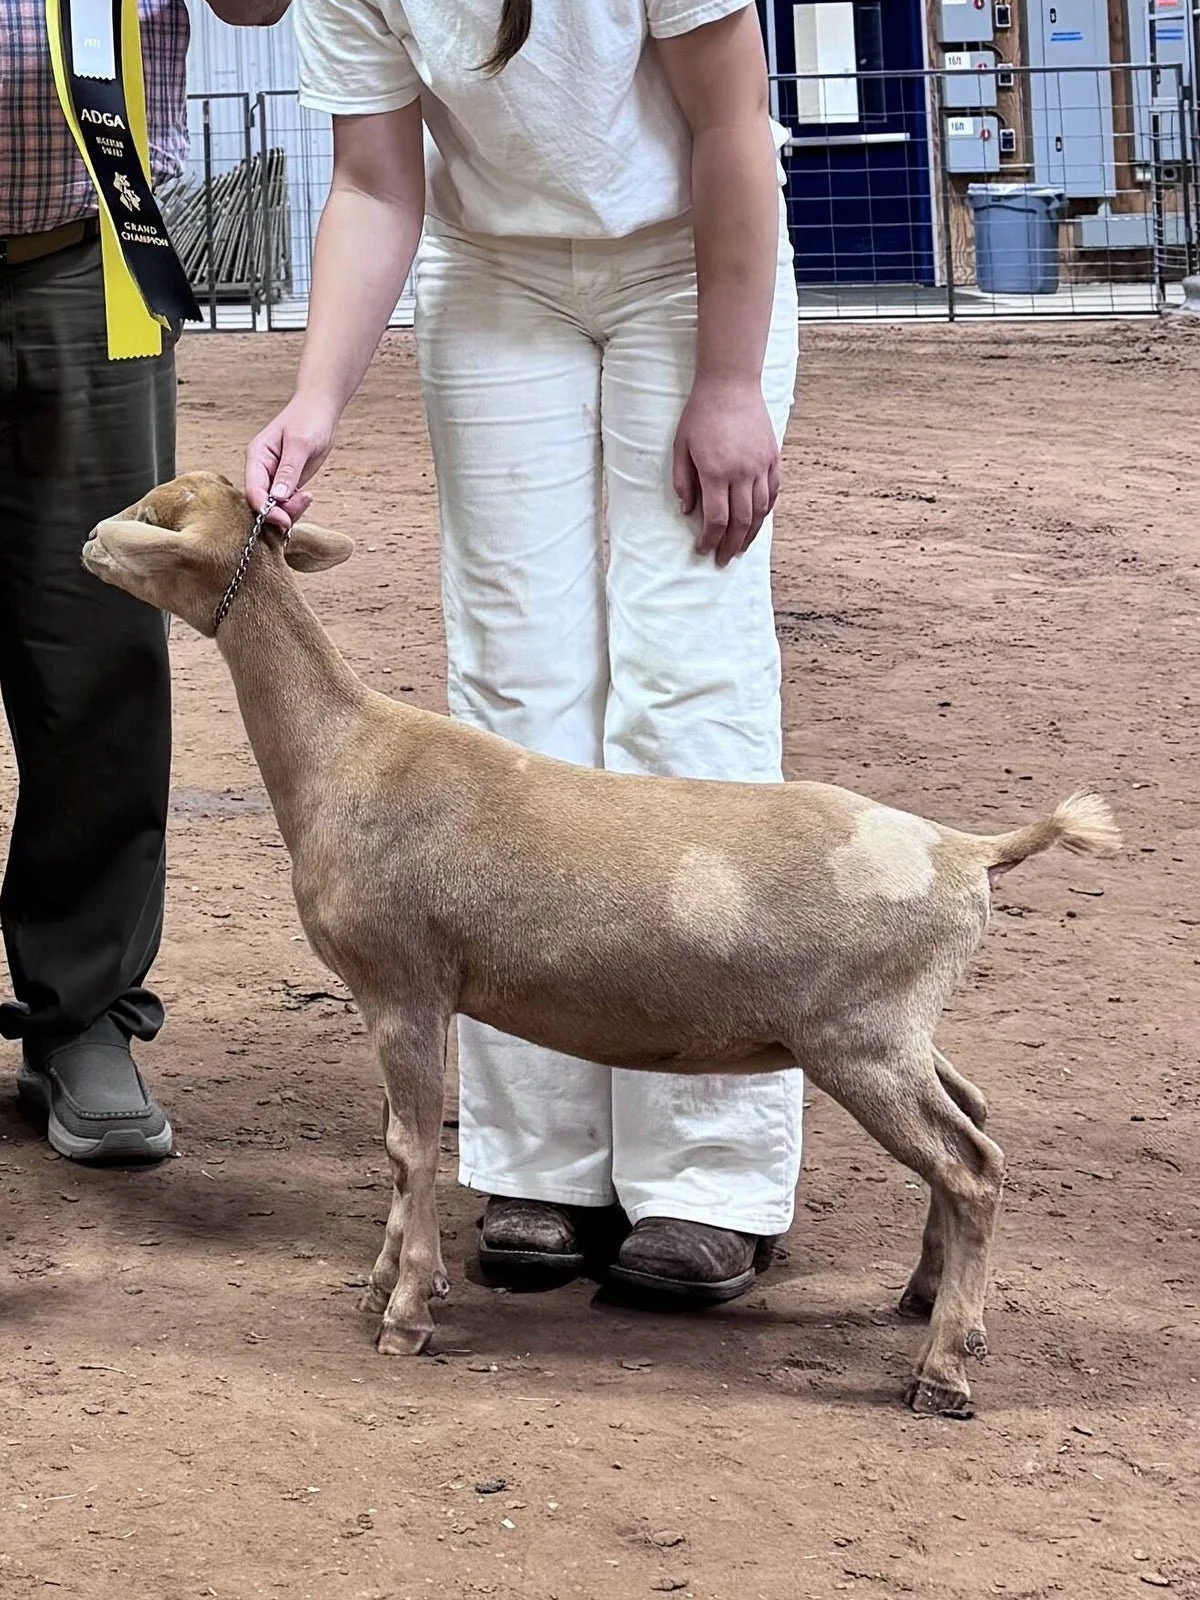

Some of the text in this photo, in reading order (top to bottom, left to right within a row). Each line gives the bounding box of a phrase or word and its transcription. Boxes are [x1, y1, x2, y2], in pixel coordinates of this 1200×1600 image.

[80, 108, 126, 130] ADGA
[124, 221, 158, 236] GRAND
[121, 231, 169, 248] CHAMPION
